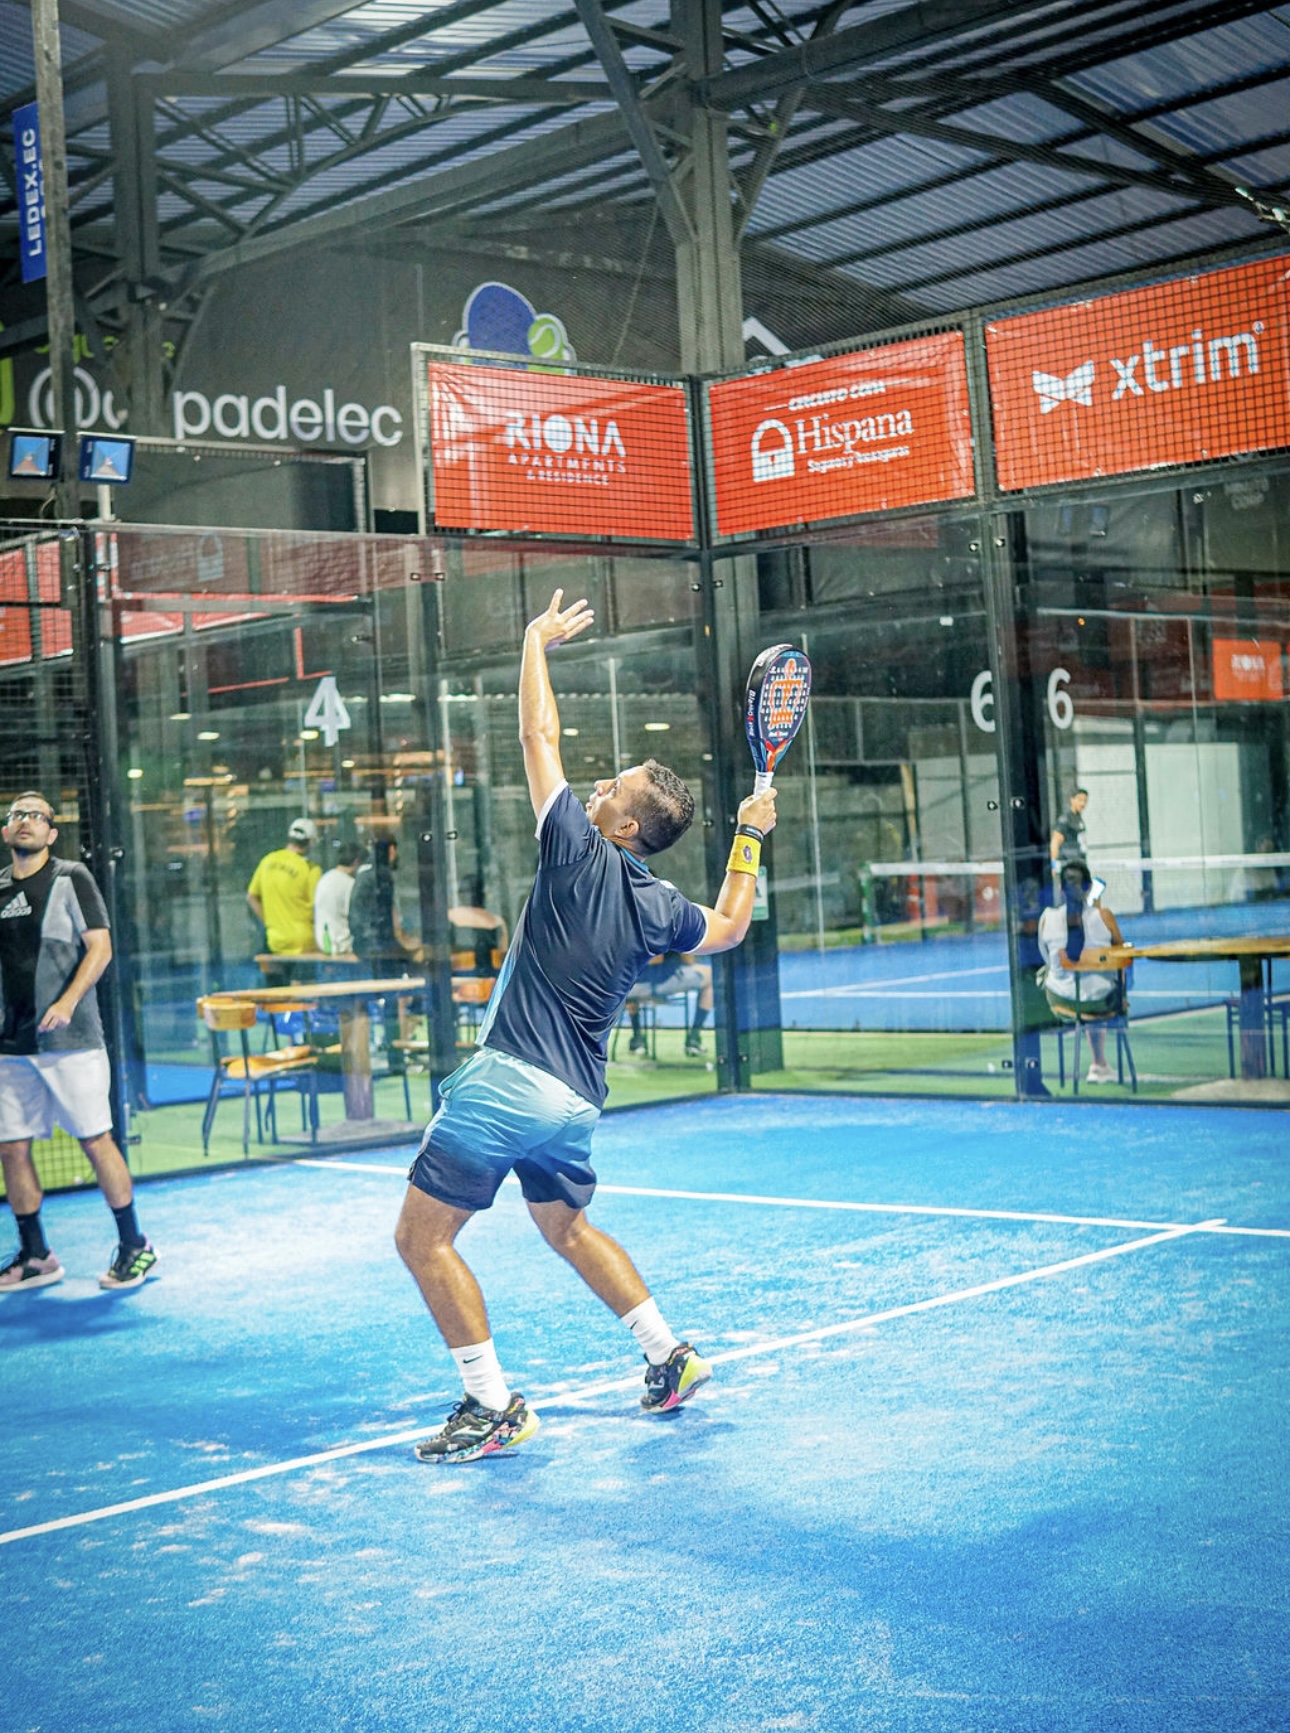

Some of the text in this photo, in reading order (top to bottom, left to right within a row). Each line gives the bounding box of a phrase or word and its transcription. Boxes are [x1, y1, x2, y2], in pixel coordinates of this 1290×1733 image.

[22, 128, 43, 257] LEDEX.EC
[1110, 329, 1260, 400] xtrim
[173, 384, 403, 452] padelec
[505, 411, 627, 457] RIONA
[795, 409, 914, 454] Hispana
[508, 453, 627, 474] APARTMENTS
[538, 470, 609, 486] RESIDENCE
[1047, 667, 1074, 730] 6
[0, 905, 33, 919] adidas
